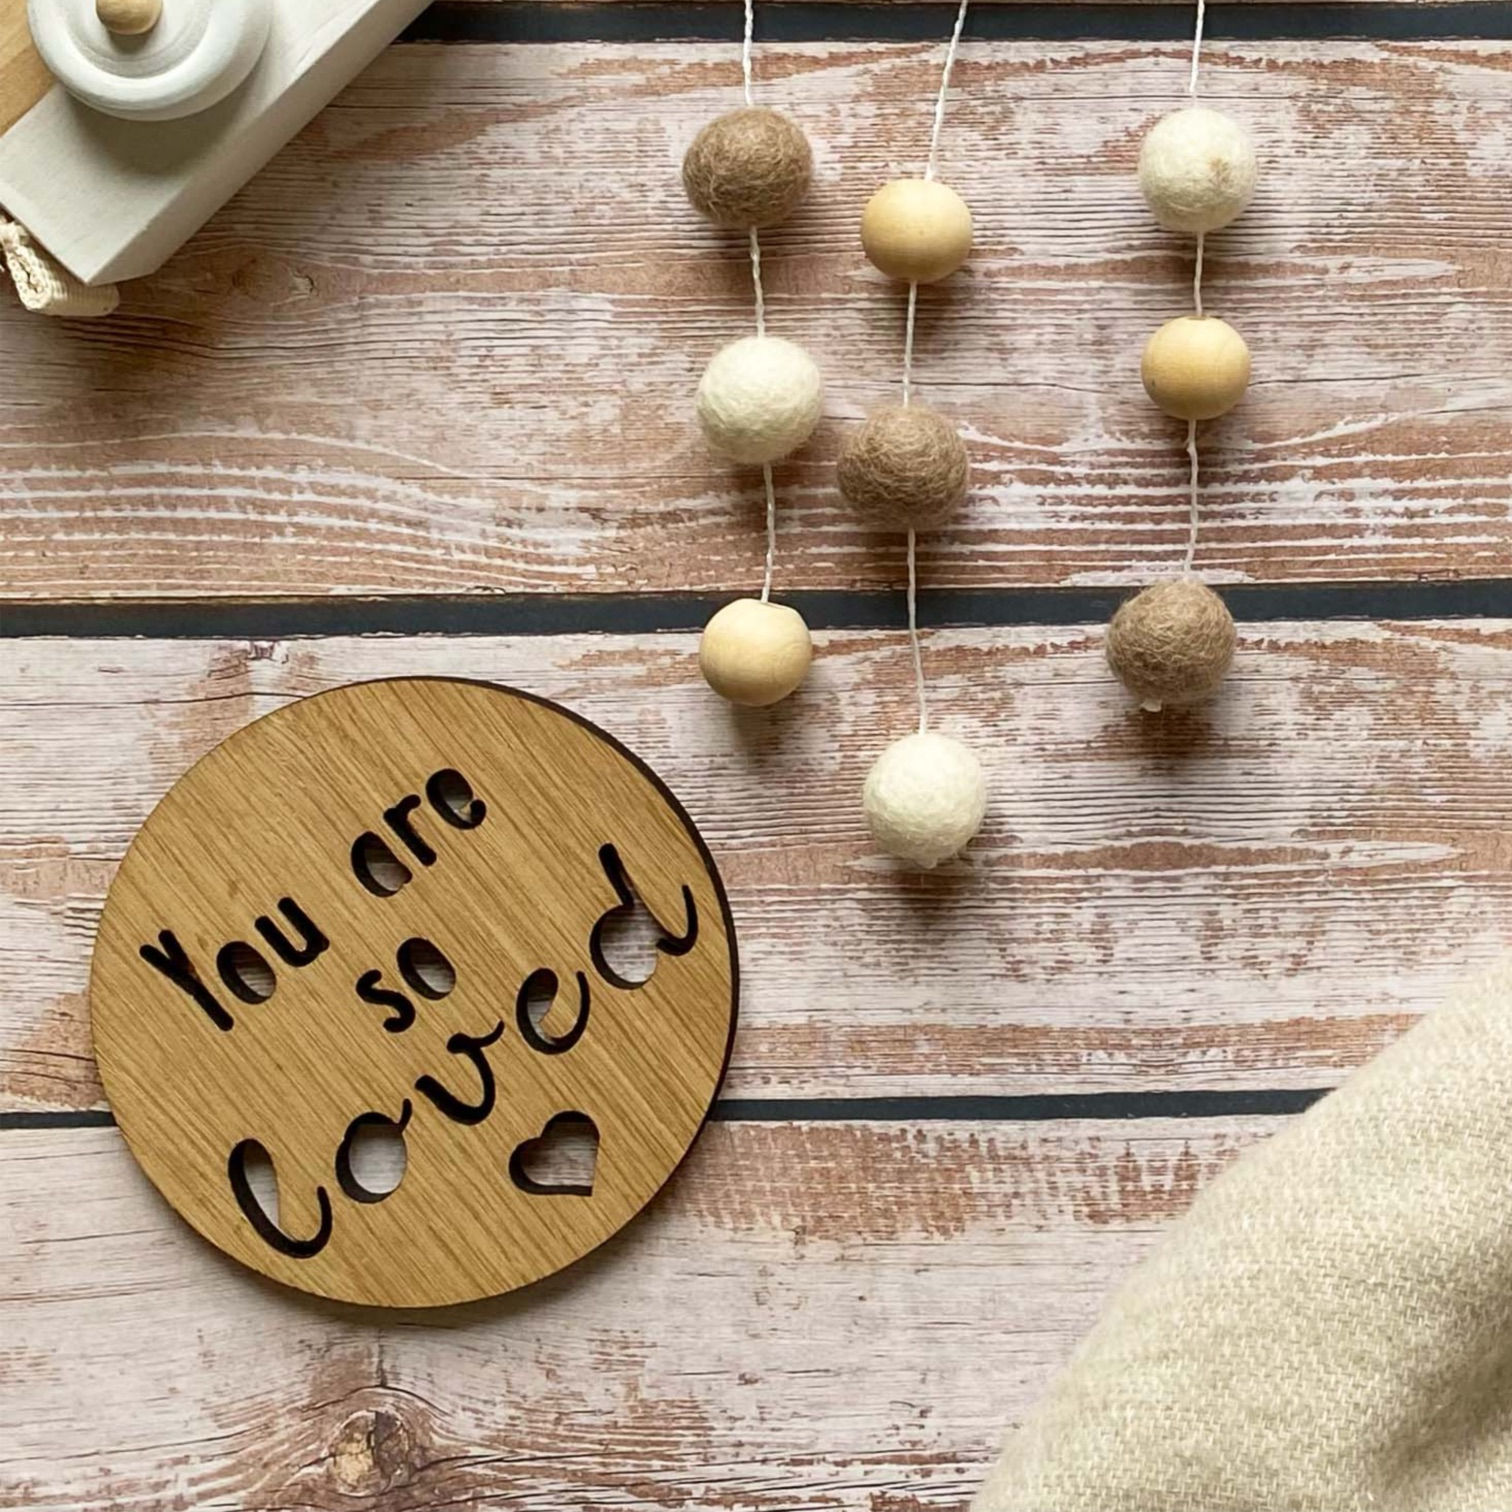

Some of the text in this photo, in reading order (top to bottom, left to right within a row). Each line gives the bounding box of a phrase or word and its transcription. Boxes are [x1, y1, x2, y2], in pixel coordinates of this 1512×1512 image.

[139, 768, 487, 1031] You are
[356, 937, 456, 1032] so
